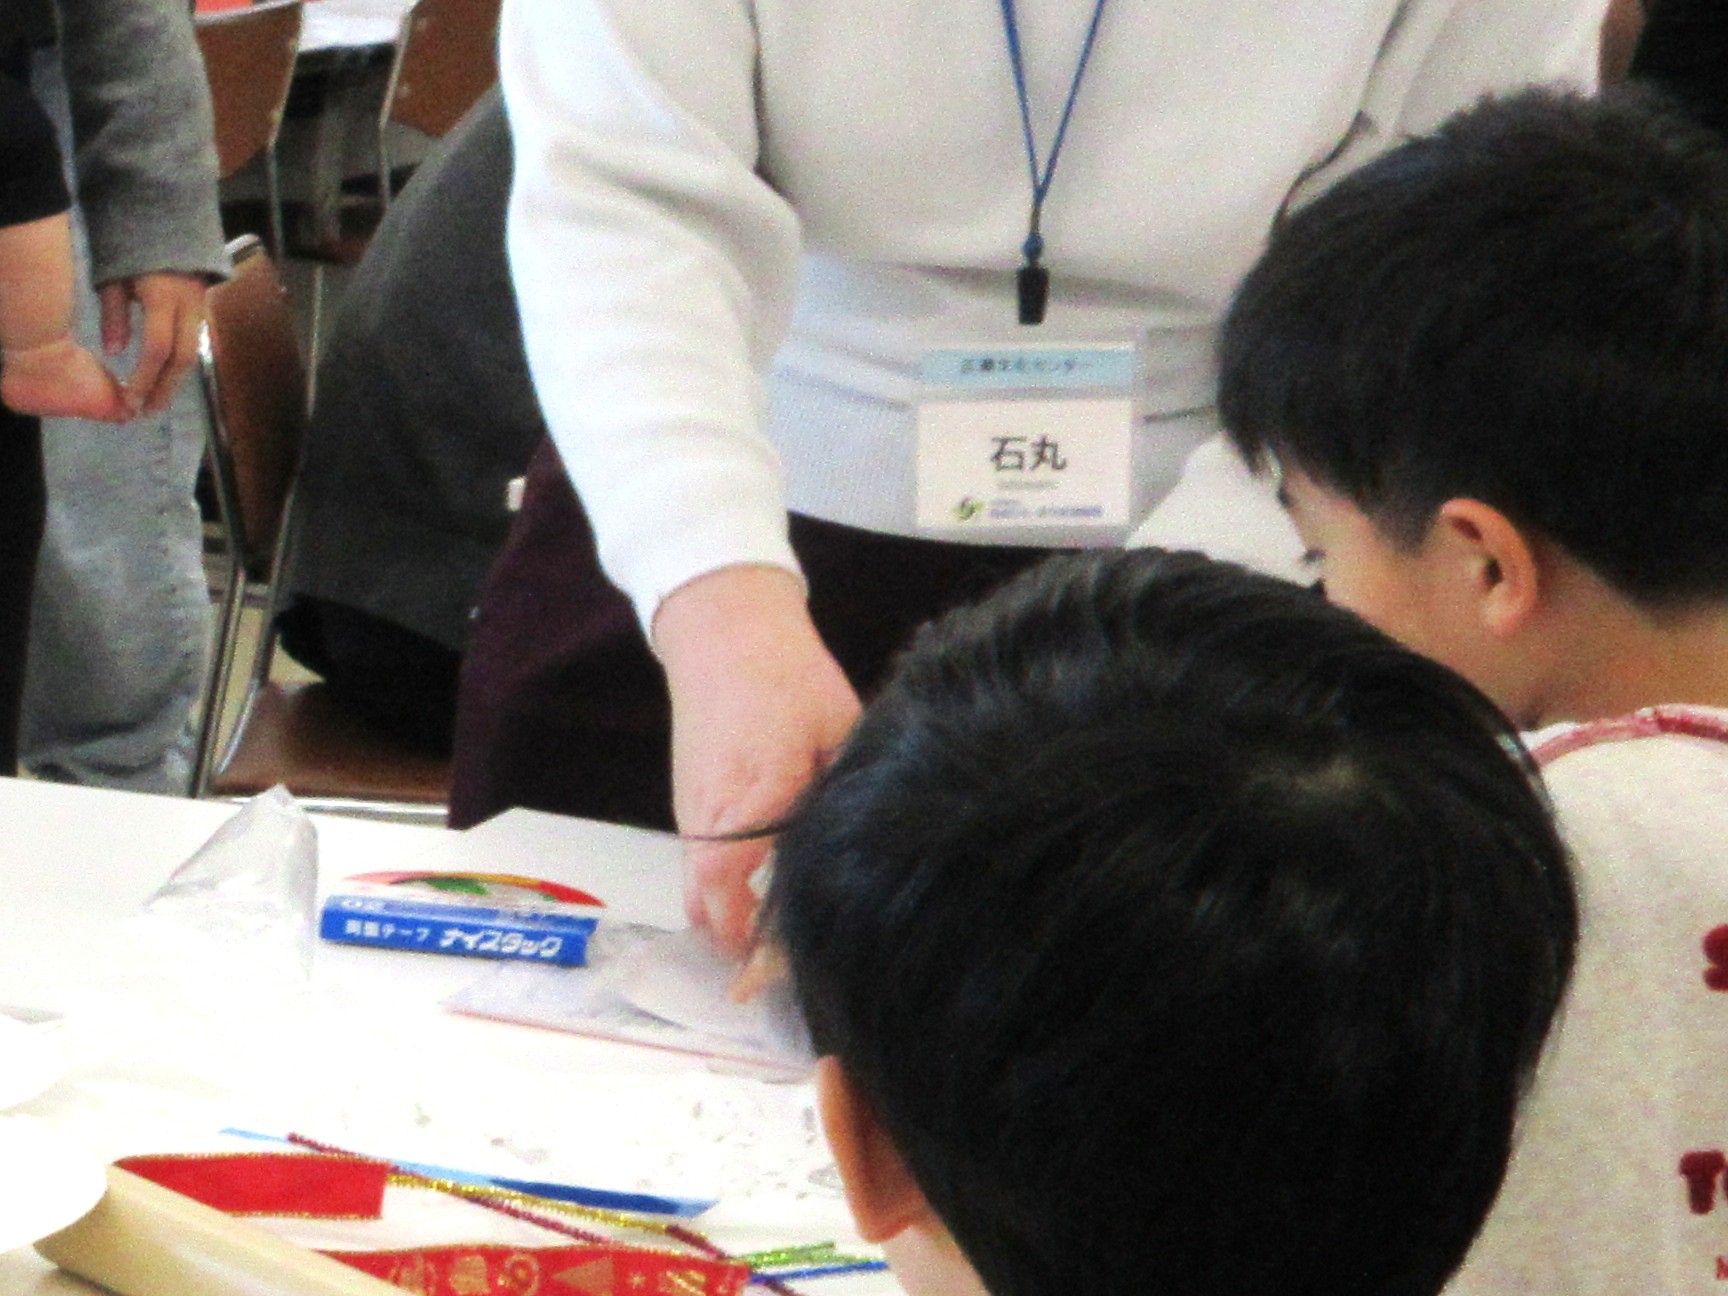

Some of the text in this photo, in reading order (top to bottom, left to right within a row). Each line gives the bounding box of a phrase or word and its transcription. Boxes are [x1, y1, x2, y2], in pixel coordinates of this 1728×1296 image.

[990, 433, 1067, 471] 石丸
[439, 927, 563, 959] ナイスタック
